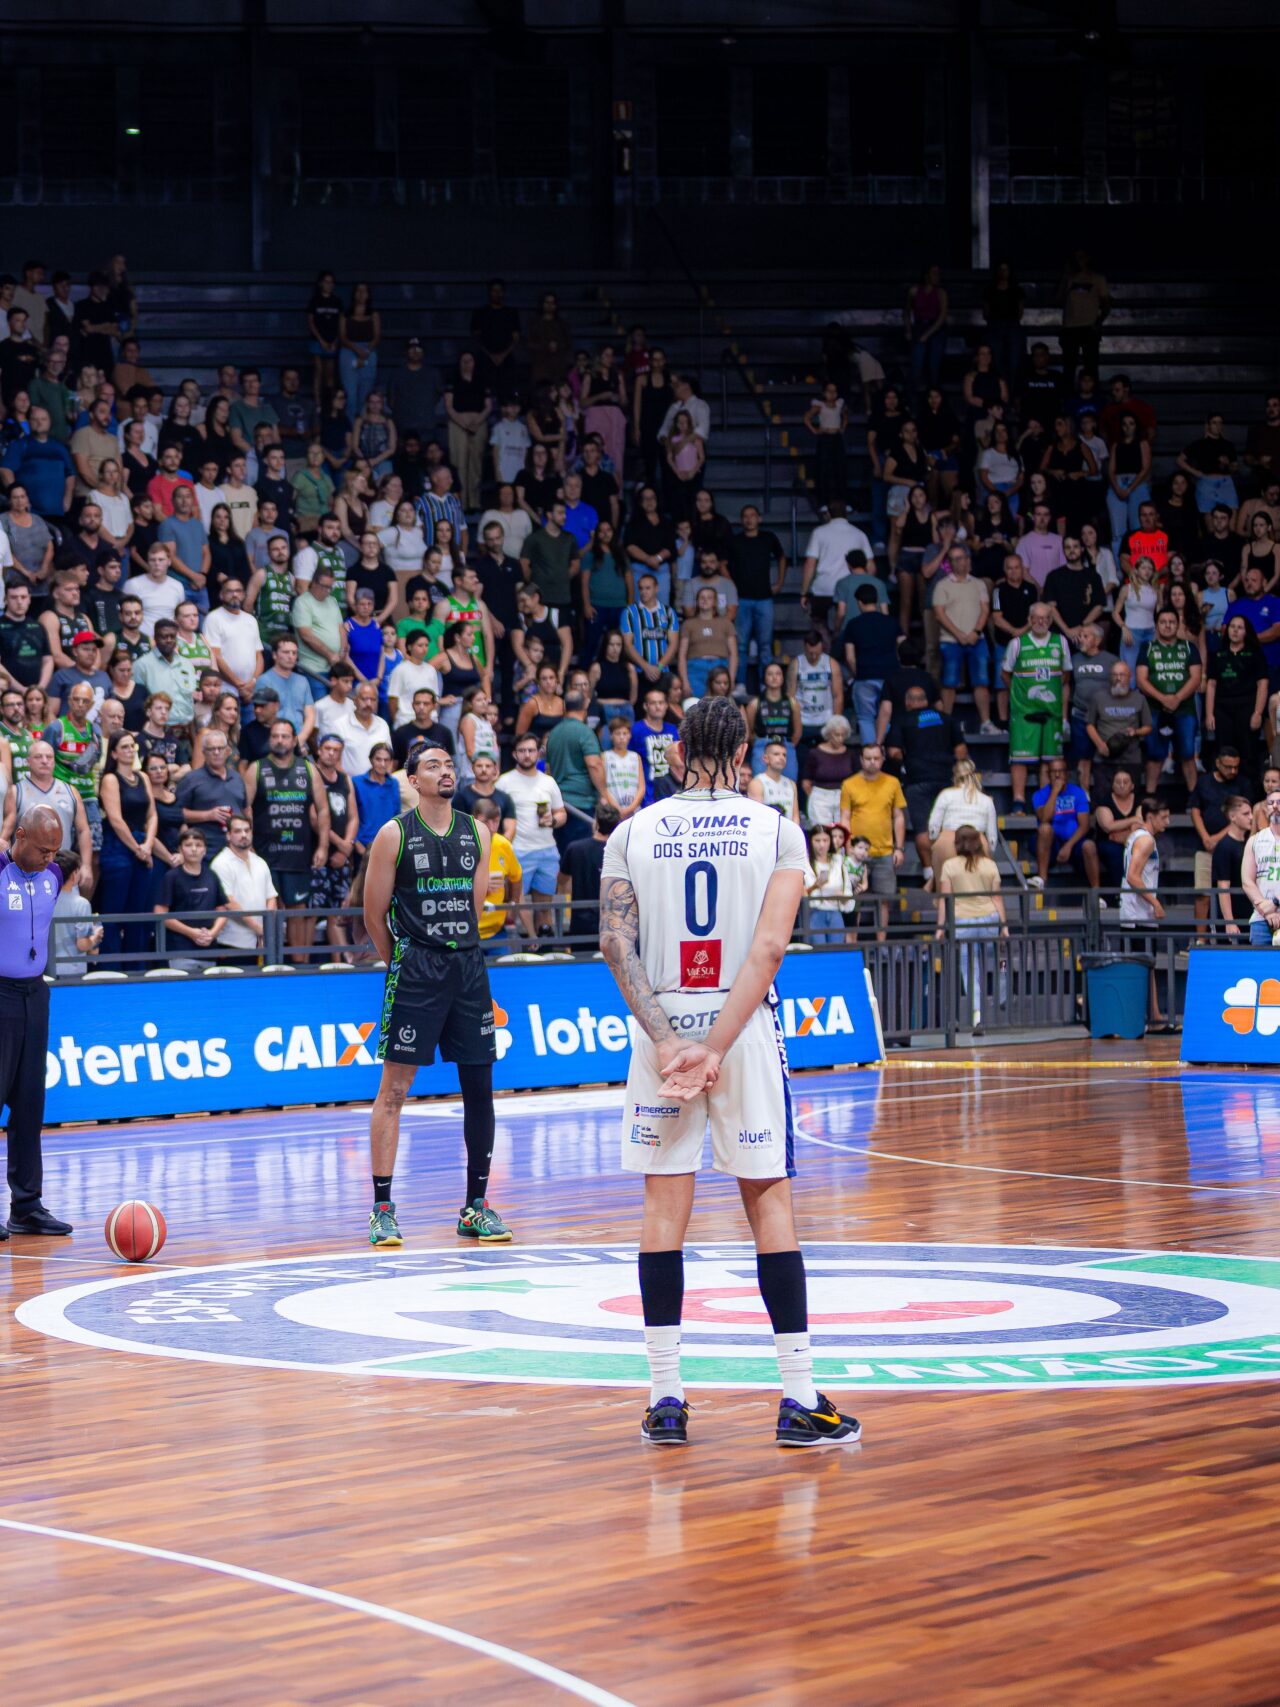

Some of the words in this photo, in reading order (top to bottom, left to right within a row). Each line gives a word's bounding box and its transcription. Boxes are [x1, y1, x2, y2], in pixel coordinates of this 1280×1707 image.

[1078, 664, 1104, 673] KTO
[272, 819, 302, 828] KTO
[692, 815, 751, 829] VINAC
[654, 843, 683, 859] DOS
[688, 841, 749, 858] SANTOS
[685, 860, 718, 937] 0
[426, 921, 470, 936] KTO
[782, 996, 854, 1037] IXA
[45, 1022, 232, 1090] oterias
[254, 1022, 384, 1072] CAIX
[739, 1128, 773, 1144] bluefit
[124, 1265, 389, 1324] ESPORTE
